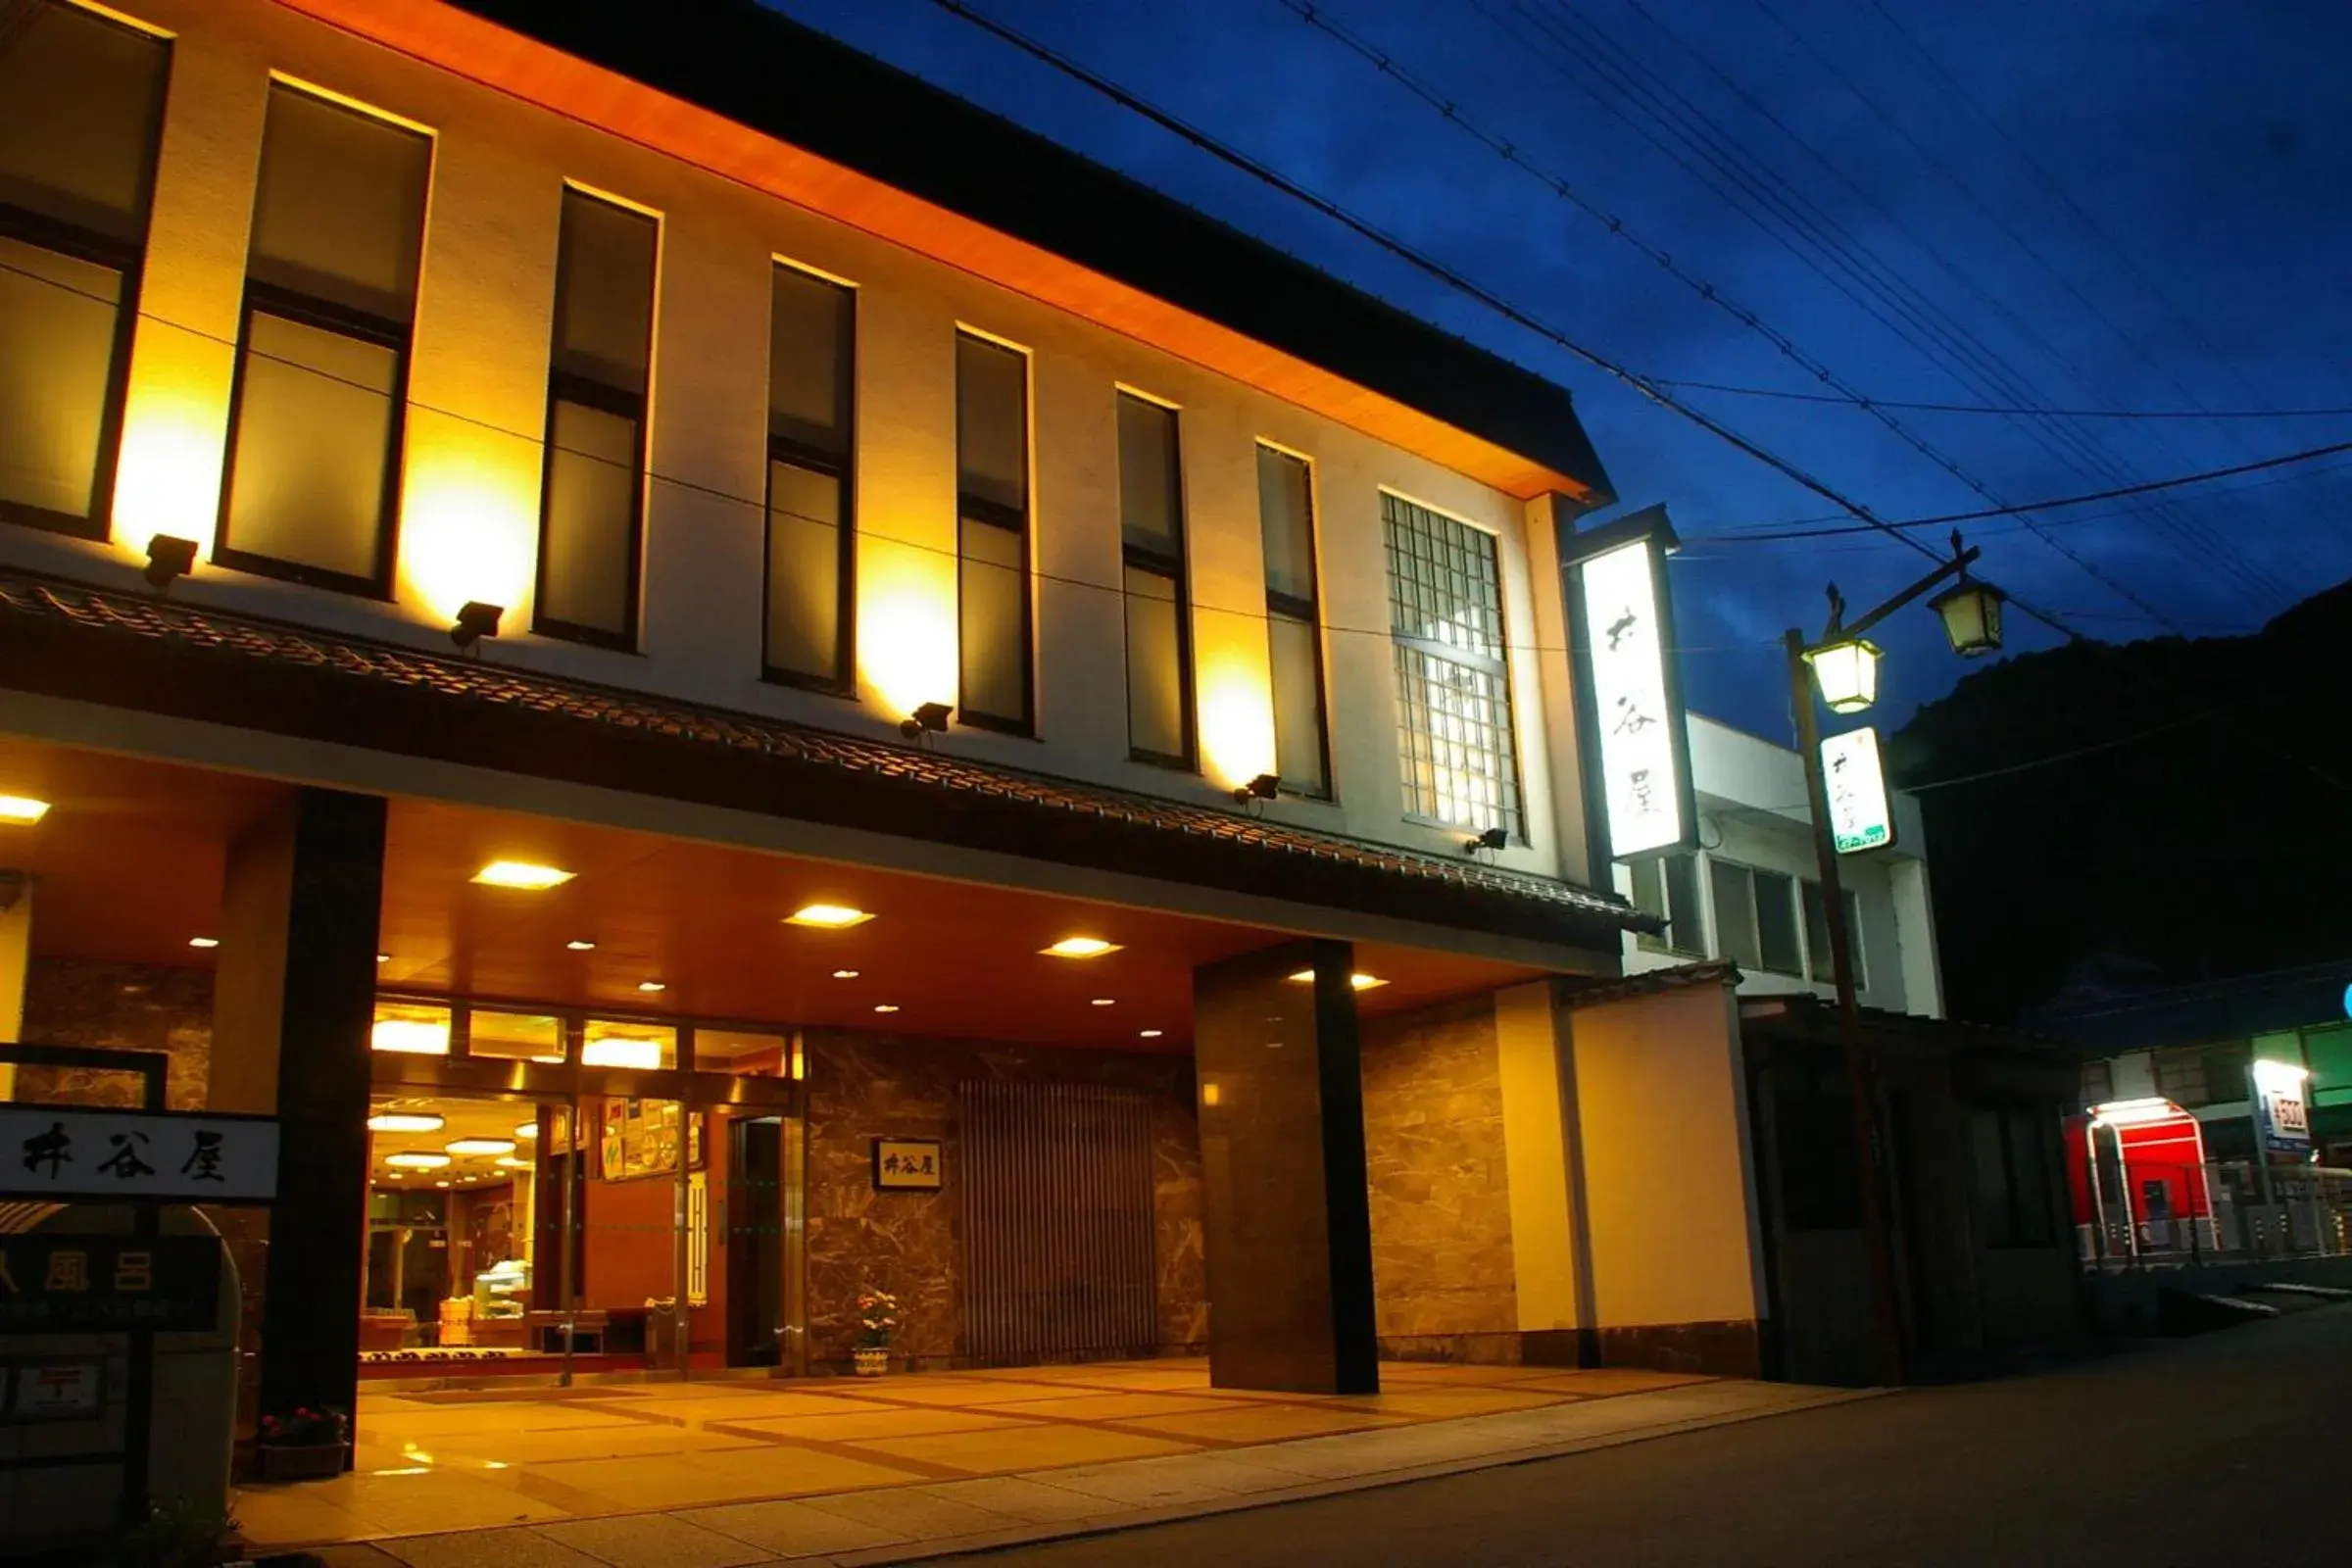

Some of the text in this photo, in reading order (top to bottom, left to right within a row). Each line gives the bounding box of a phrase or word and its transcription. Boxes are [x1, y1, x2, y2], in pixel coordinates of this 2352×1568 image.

[23, 1122, 225, 1182] 井谷屋
[883, 1152, 936, 1176] 井谷屋
